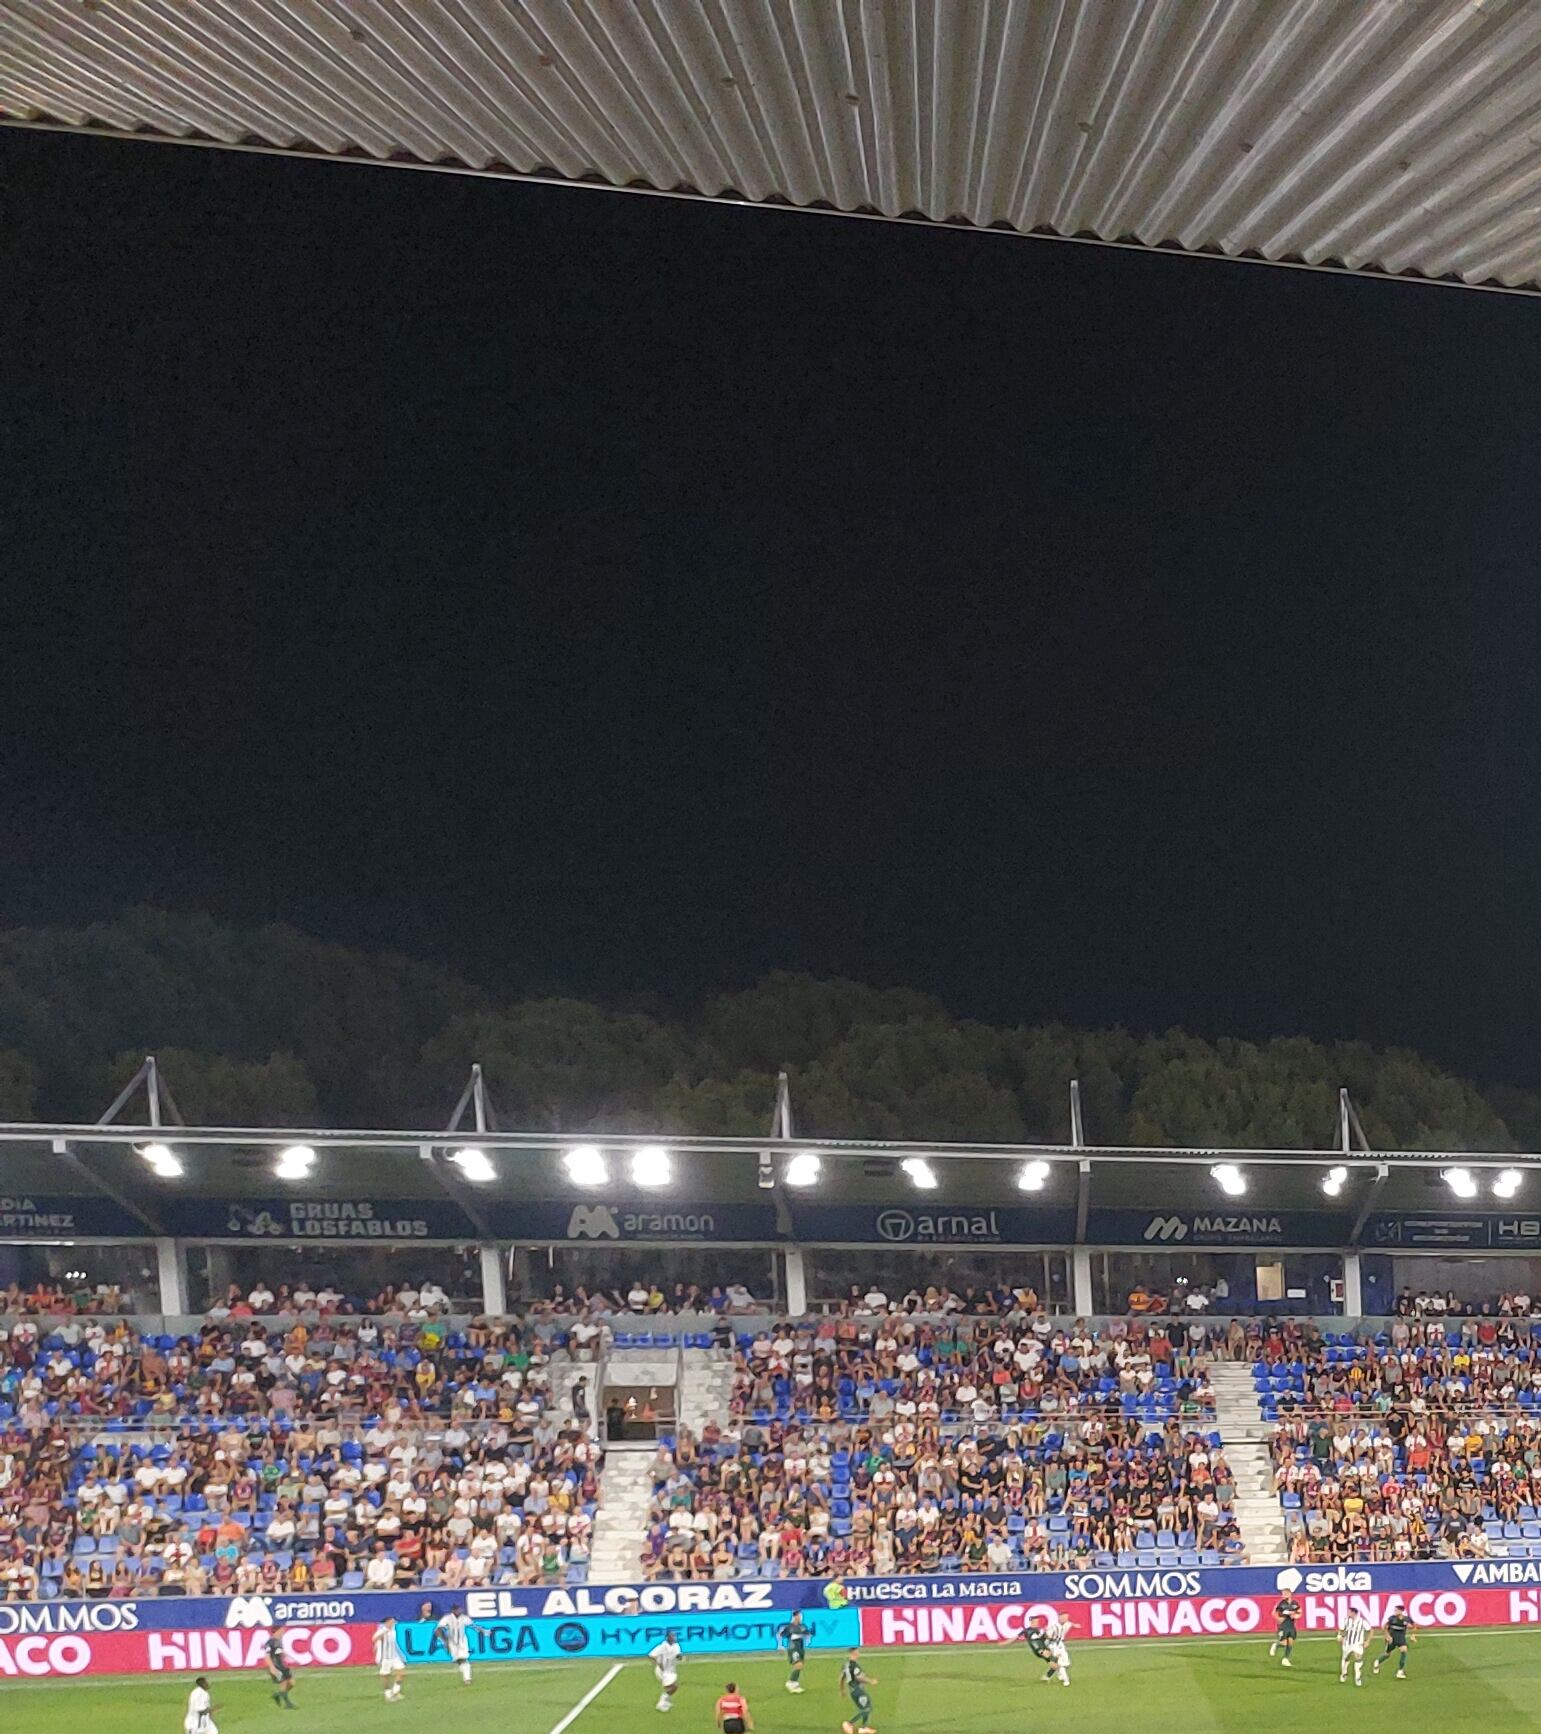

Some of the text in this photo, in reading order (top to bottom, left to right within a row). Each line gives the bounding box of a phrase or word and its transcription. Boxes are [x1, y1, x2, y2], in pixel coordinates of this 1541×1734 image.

[0, 1214, 75, 1227] RTINEZ
[290, 1203, 373, 1219] GRUAS
[623, 1213, 714, 1231] aramon
[916, 1211, 1000, 1235] arnal
[1193, 1216, 1282, 1232] MAZANA
[1065, 1570, 1201, 1599] SOMMOS
[1306, 1566, 1372, 1592] soka
[274, 1599, 355, 1619] aramon
[466, 1583, 773, 1618] EL ALCORAZ
[1305, 1591, 1467, 1629] HINACO
[881, 1604, 1060, 1645] HINACO
[1091, 1598, 1261, 1638] HINACO
[148, 1627, 351, 1671] HINACO
[405, 1621, 816, 1657] LAIGA HYPERMOTI
